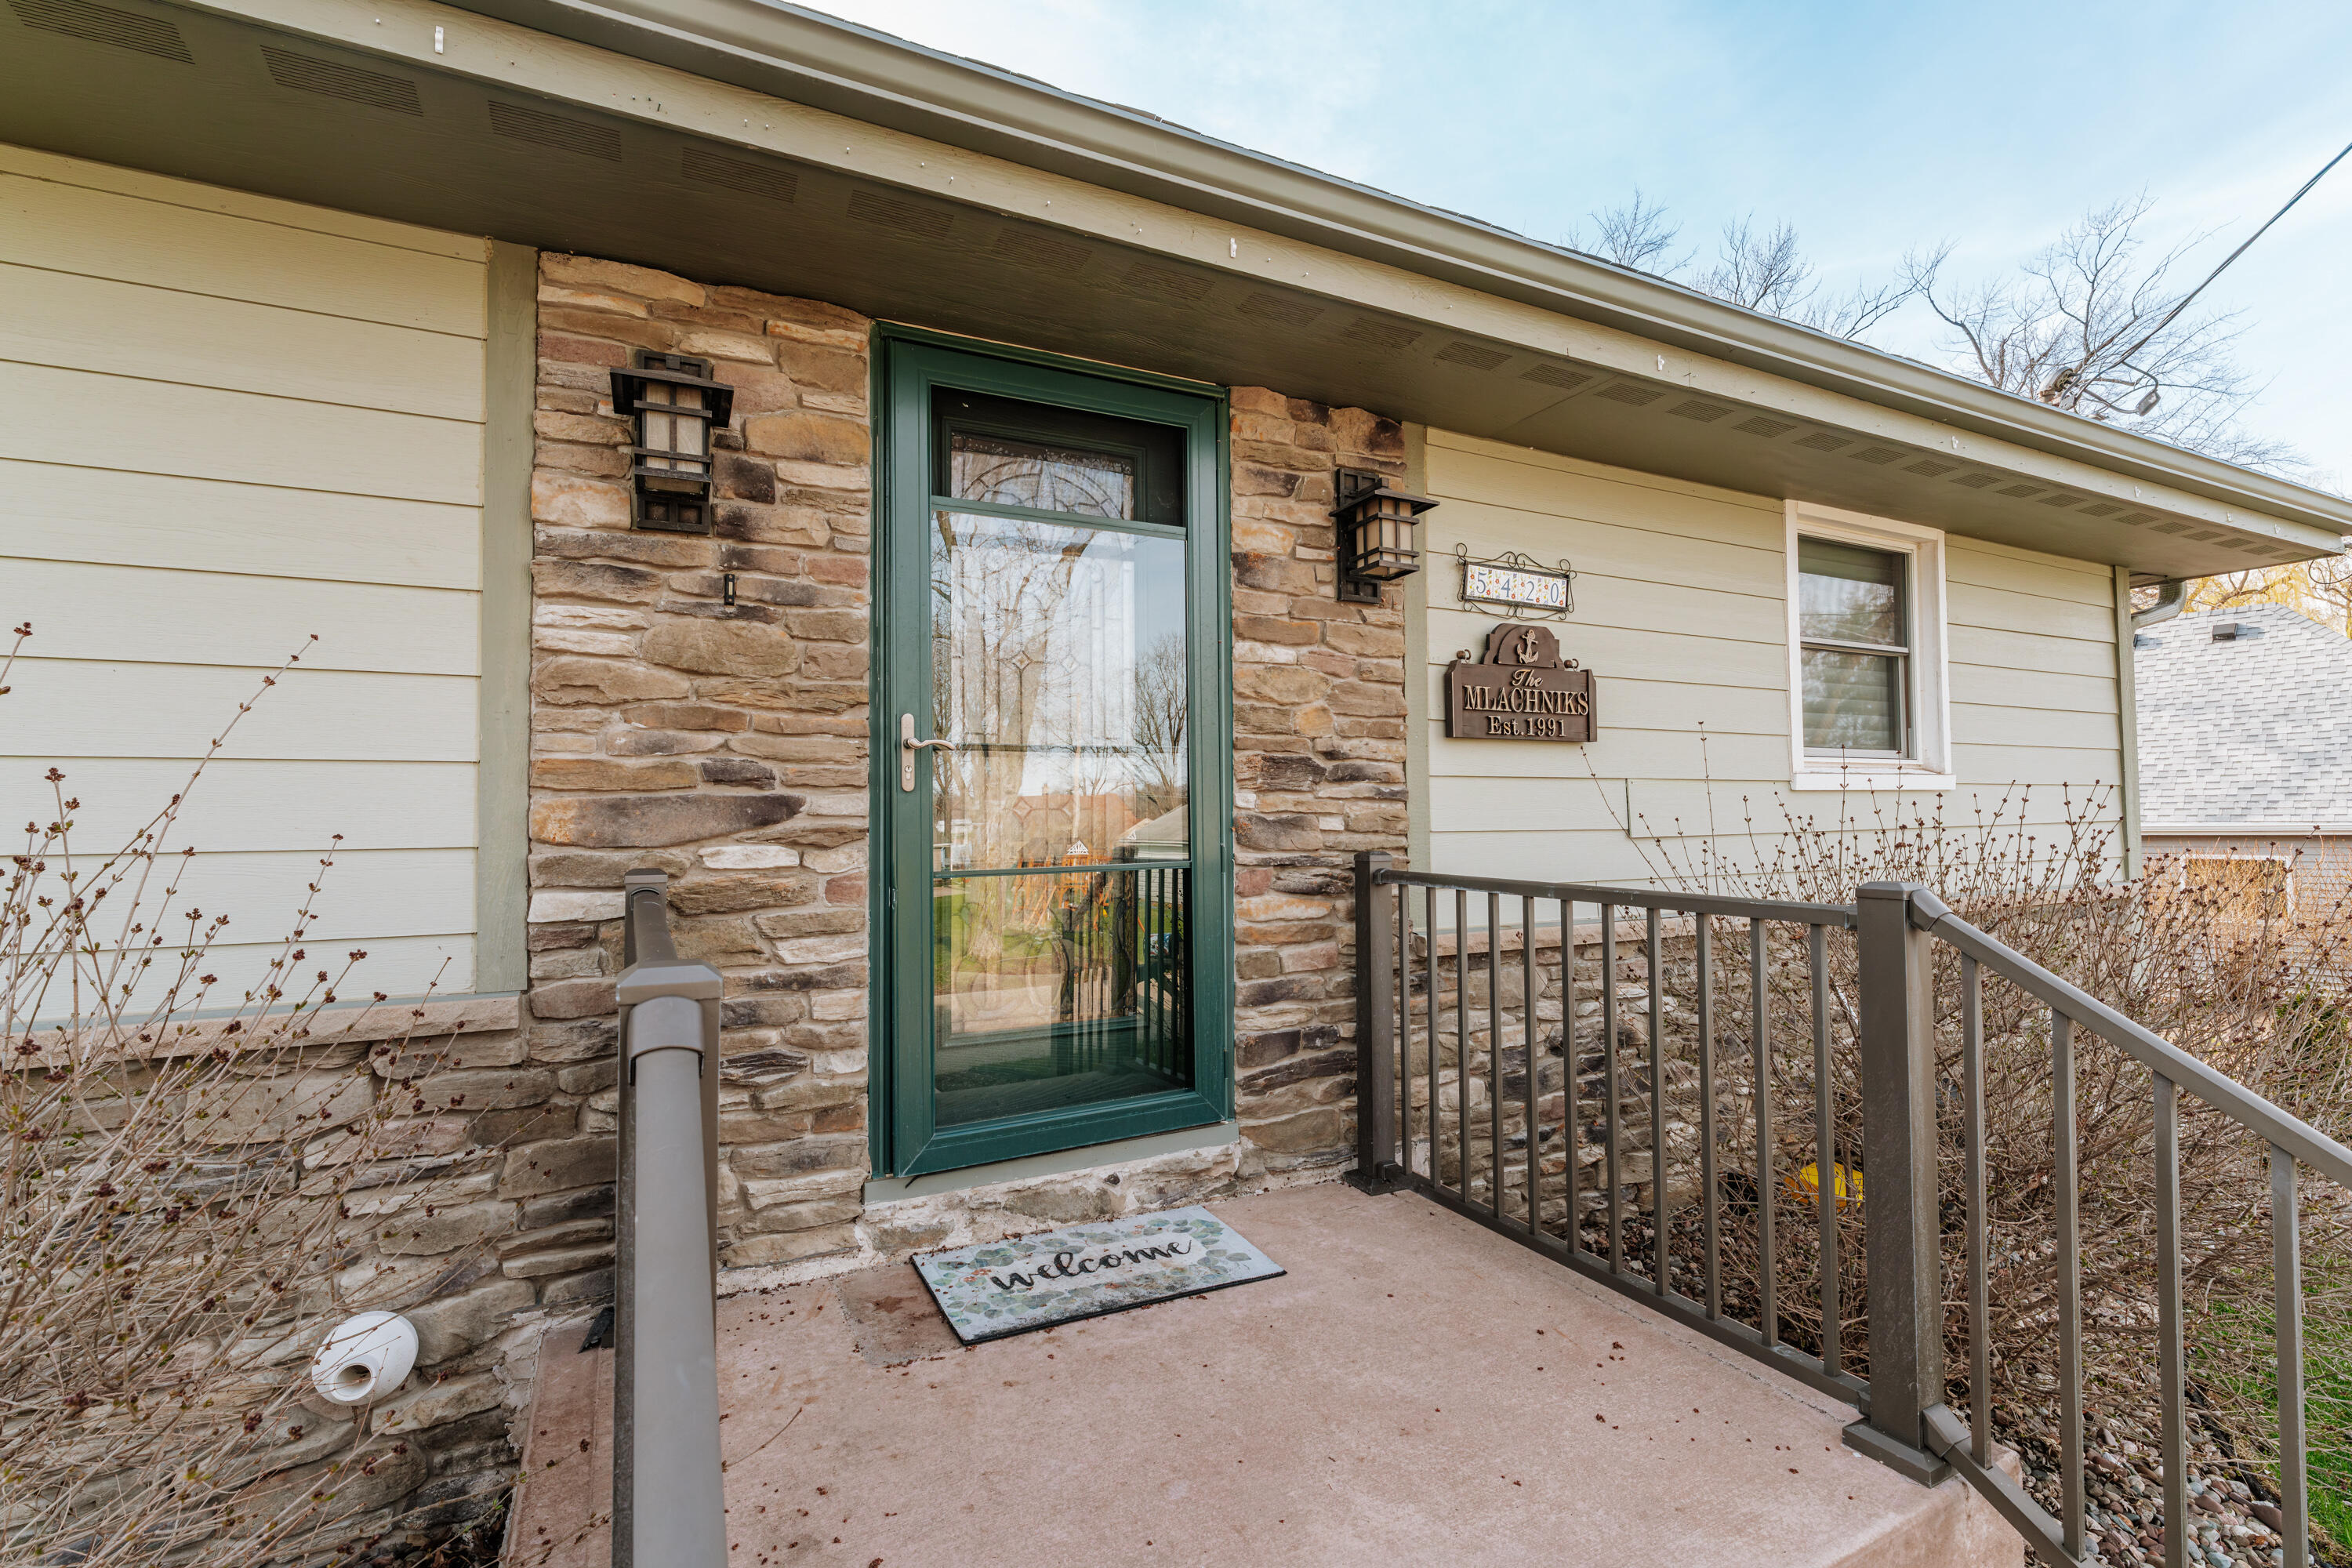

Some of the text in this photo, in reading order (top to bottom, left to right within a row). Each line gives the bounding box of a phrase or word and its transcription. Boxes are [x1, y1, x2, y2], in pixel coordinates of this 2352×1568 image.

[1475, 571, 1559, 604] 5420
[1512, 669, 1544, 688] The
[1464, 684, 1589, 716] MLACHNIKS
[990, 1240, 1192, 1290] welcome
